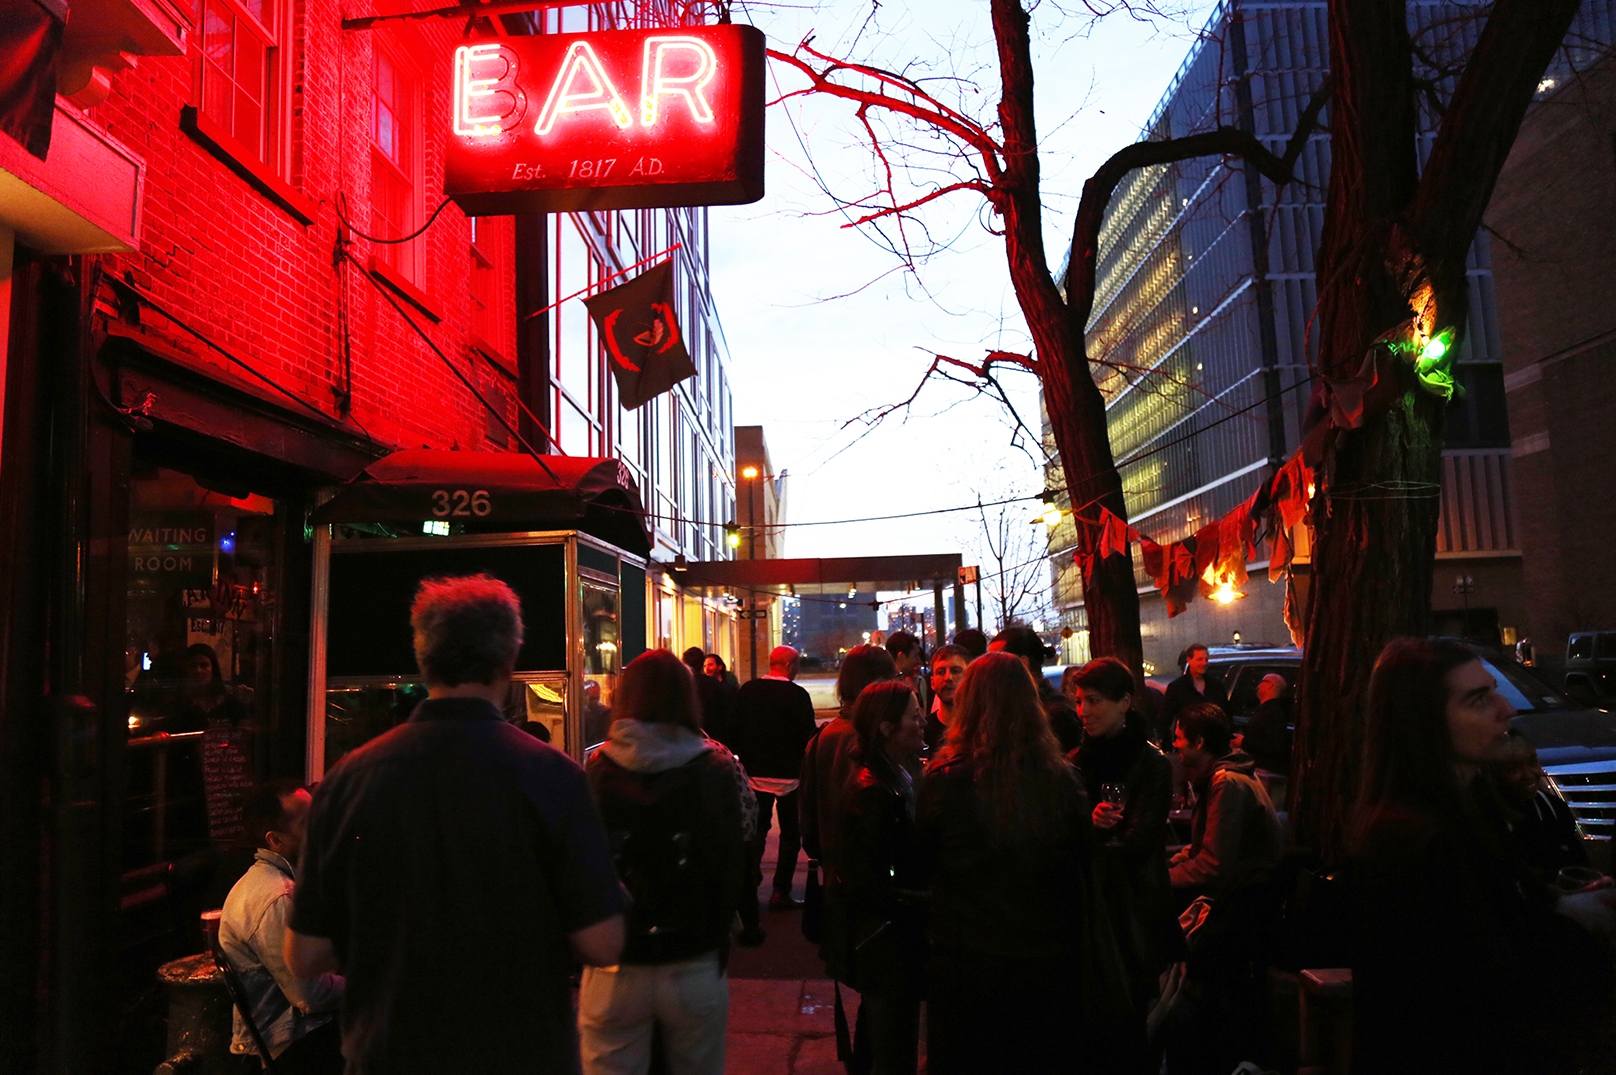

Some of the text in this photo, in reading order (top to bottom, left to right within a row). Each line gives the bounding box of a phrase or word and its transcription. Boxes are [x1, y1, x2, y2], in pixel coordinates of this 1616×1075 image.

[512, 156, 665, 180] Est. 1817 A.D.
[431, 489, 492, 517] 326
[135, 556, 192, 571] ROOM
